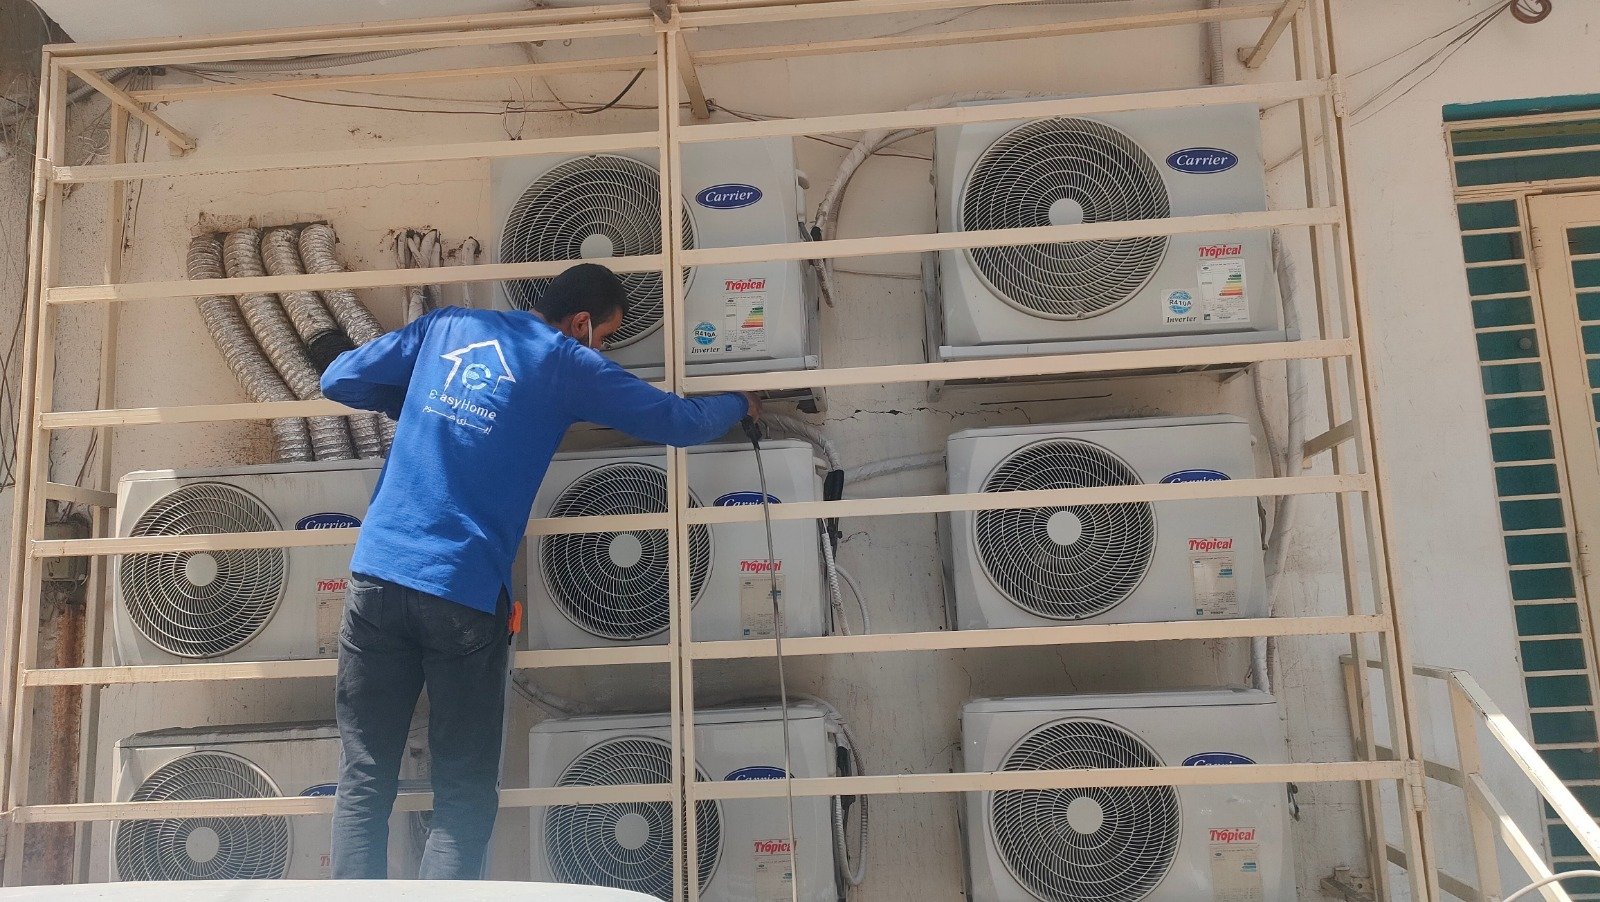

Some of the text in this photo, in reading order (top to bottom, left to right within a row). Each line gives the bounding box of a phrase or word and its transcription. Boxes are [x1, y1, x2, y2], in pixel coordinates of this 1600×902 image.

[1176, 154, 1228, 166] Carrier
[705, 190, 753, 203] Carrier
[1198, 245, 1242, 258] Tropical
[724, 279, 766, 292] Tropical
[1169, 299, 1192, 307] R410A
[694, 330, 716, 338] R410A
[691, 346, 721, 354] Inverter
[1188, 538, 1233, 552] Tropical
[316, 579, 348, 592] Tropic
[1209, 828, 1255, 843] Tropical
